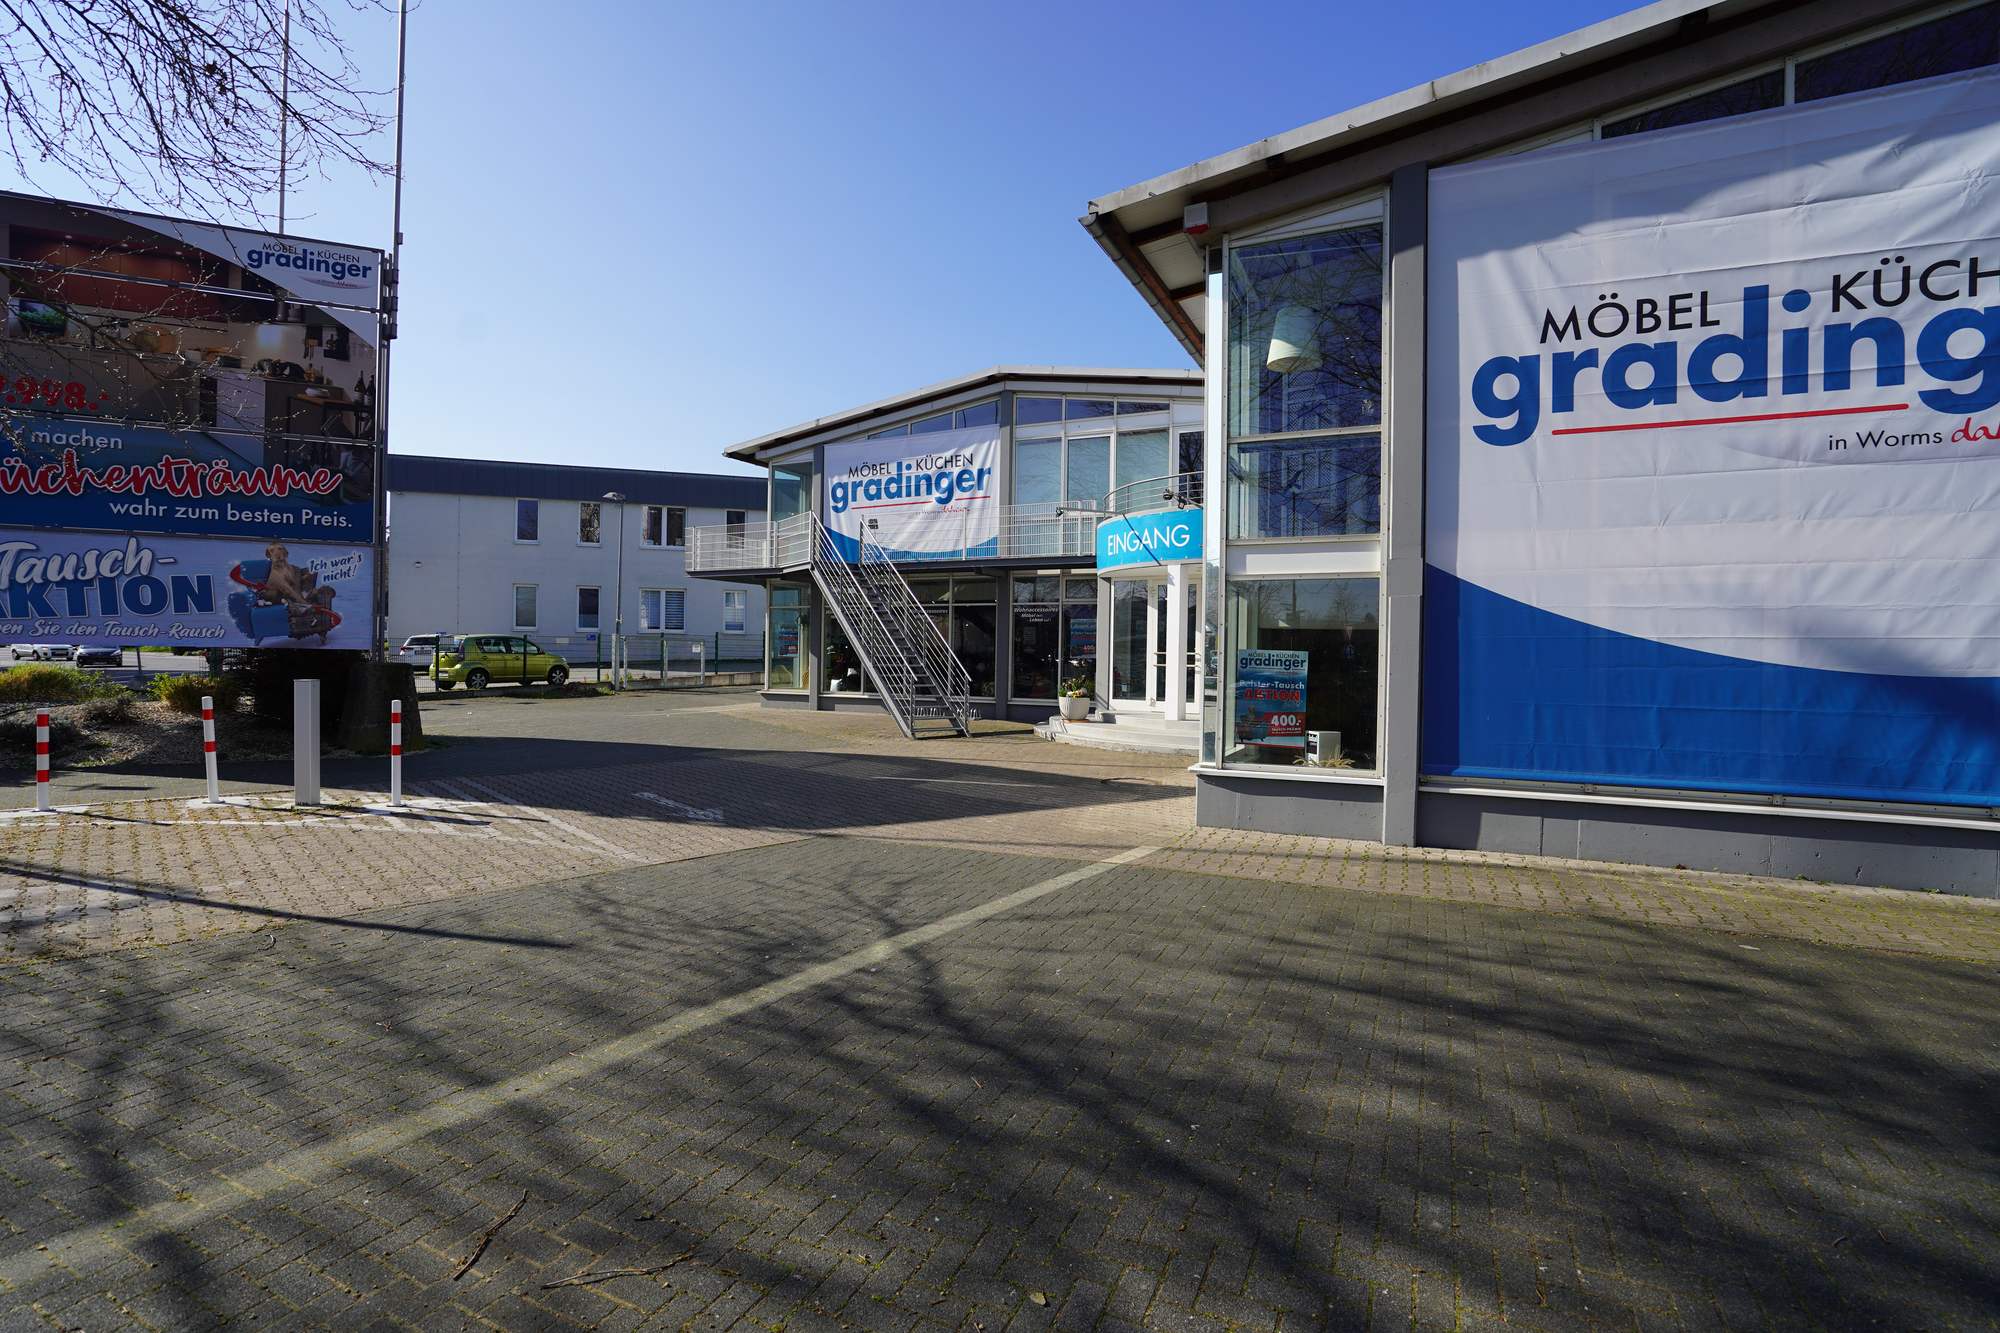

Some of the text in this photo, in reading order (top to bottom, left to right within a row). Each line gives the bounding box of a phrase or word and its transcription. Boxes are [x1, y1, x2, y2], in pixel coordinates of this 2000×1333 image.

[247, 248, 372, 281] gradinger
[262, 242, 360, 264] MÖBEL KÜCHEN
[1539, 290, 1721, 344] MÖBEL
[1471, 284, 2000, 447] grading
[31, 428, 122, 449] machen
[1829, 417, 2000, 451] in Worms da
[848, 453, 974, 479] MÖBEL KÜCHEN
[831, 461, 992, 513] gradinger
[109, 498, 353, 528] wahr zum besten Preis.
[1107, 524, 1190, 556] EINGANG
[310, 551, 362, 572] Ich war's
[323, 564, 357, 582] nicht!
[0, 622, 24, 635] en
[29, 619, 61, 637] Sie
[65, 621, 98, 637] den
[1240, 653, 1306, 671] gradinger
